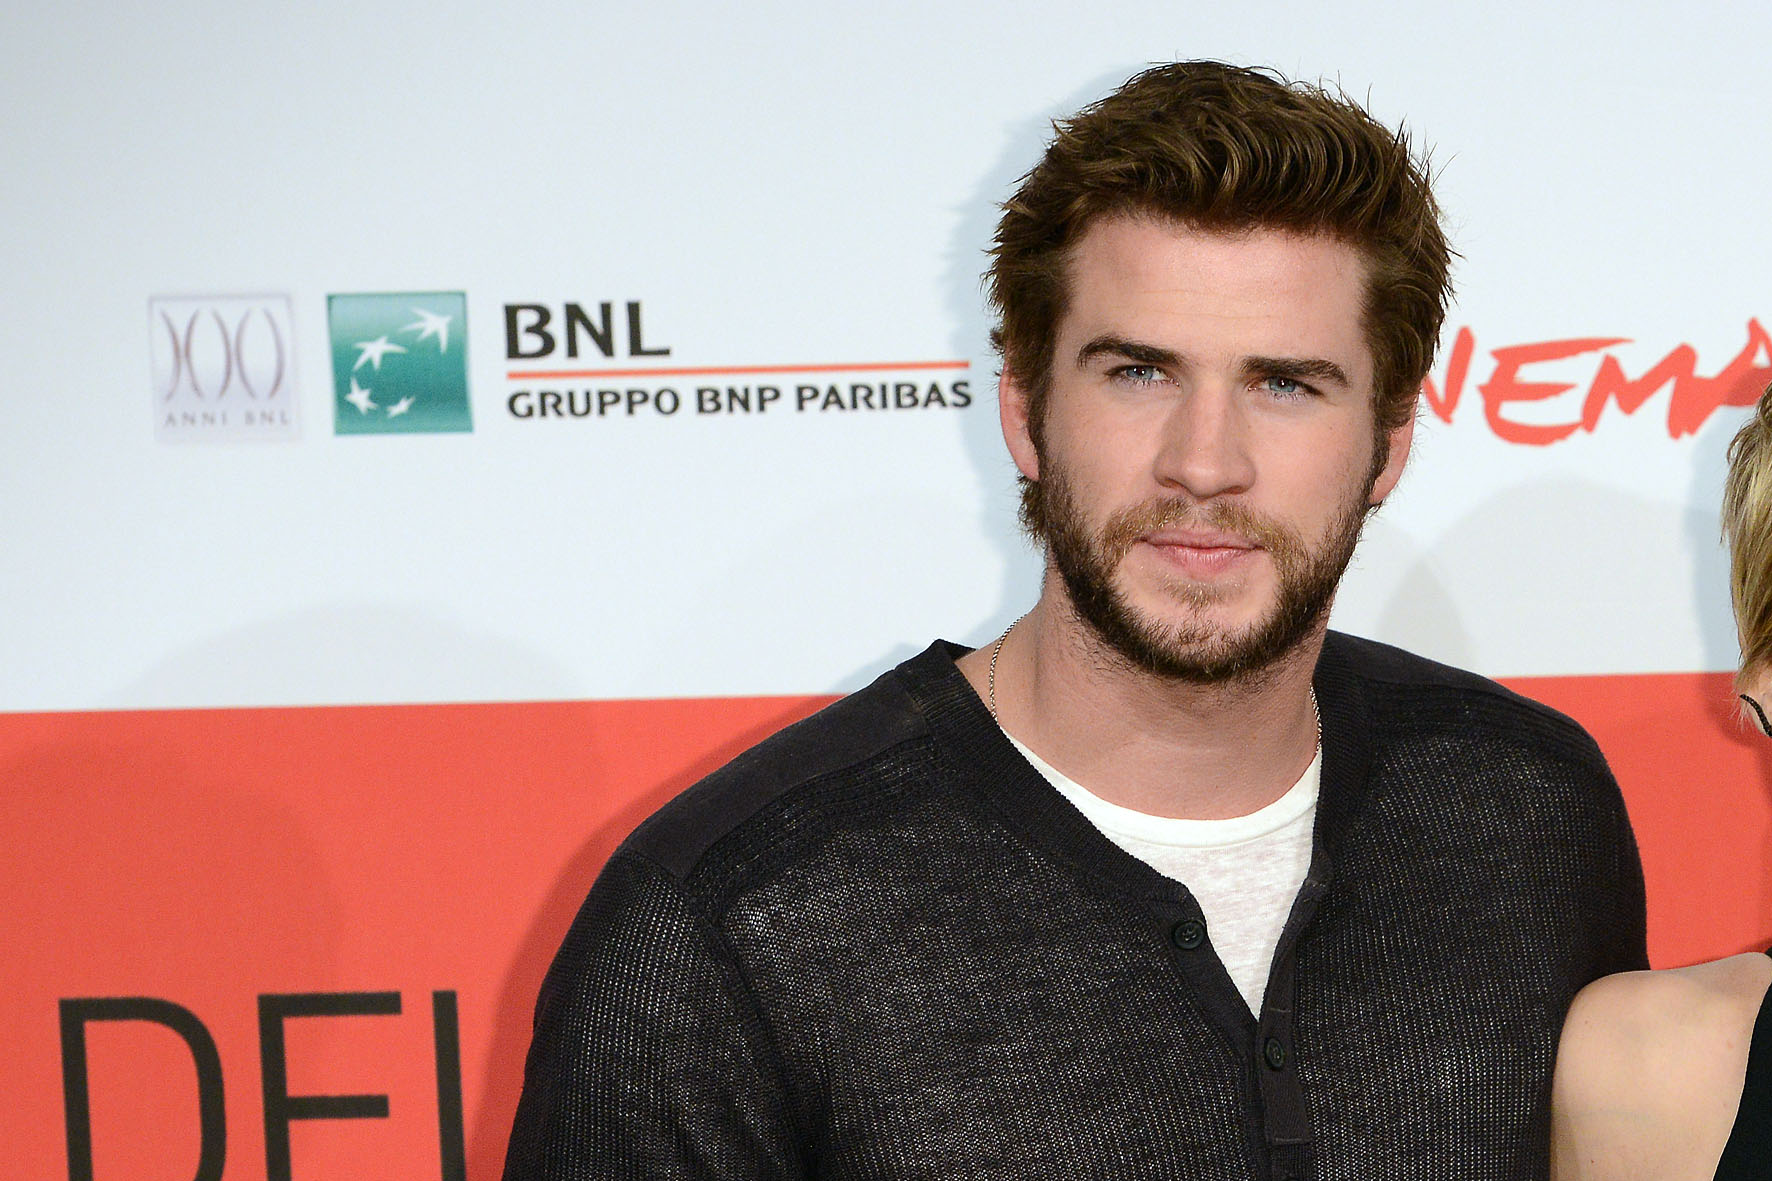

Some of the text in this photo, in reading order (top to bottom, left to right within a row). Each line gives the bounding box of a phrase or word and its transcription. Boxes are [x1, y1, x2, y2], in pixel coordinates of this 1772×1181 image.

[503, 301, 673, 360] BNL
[506, 380, 974, 418] GRUPPO BNP PARIBAS
[163, 409, 289, 428] ANNI BNL
